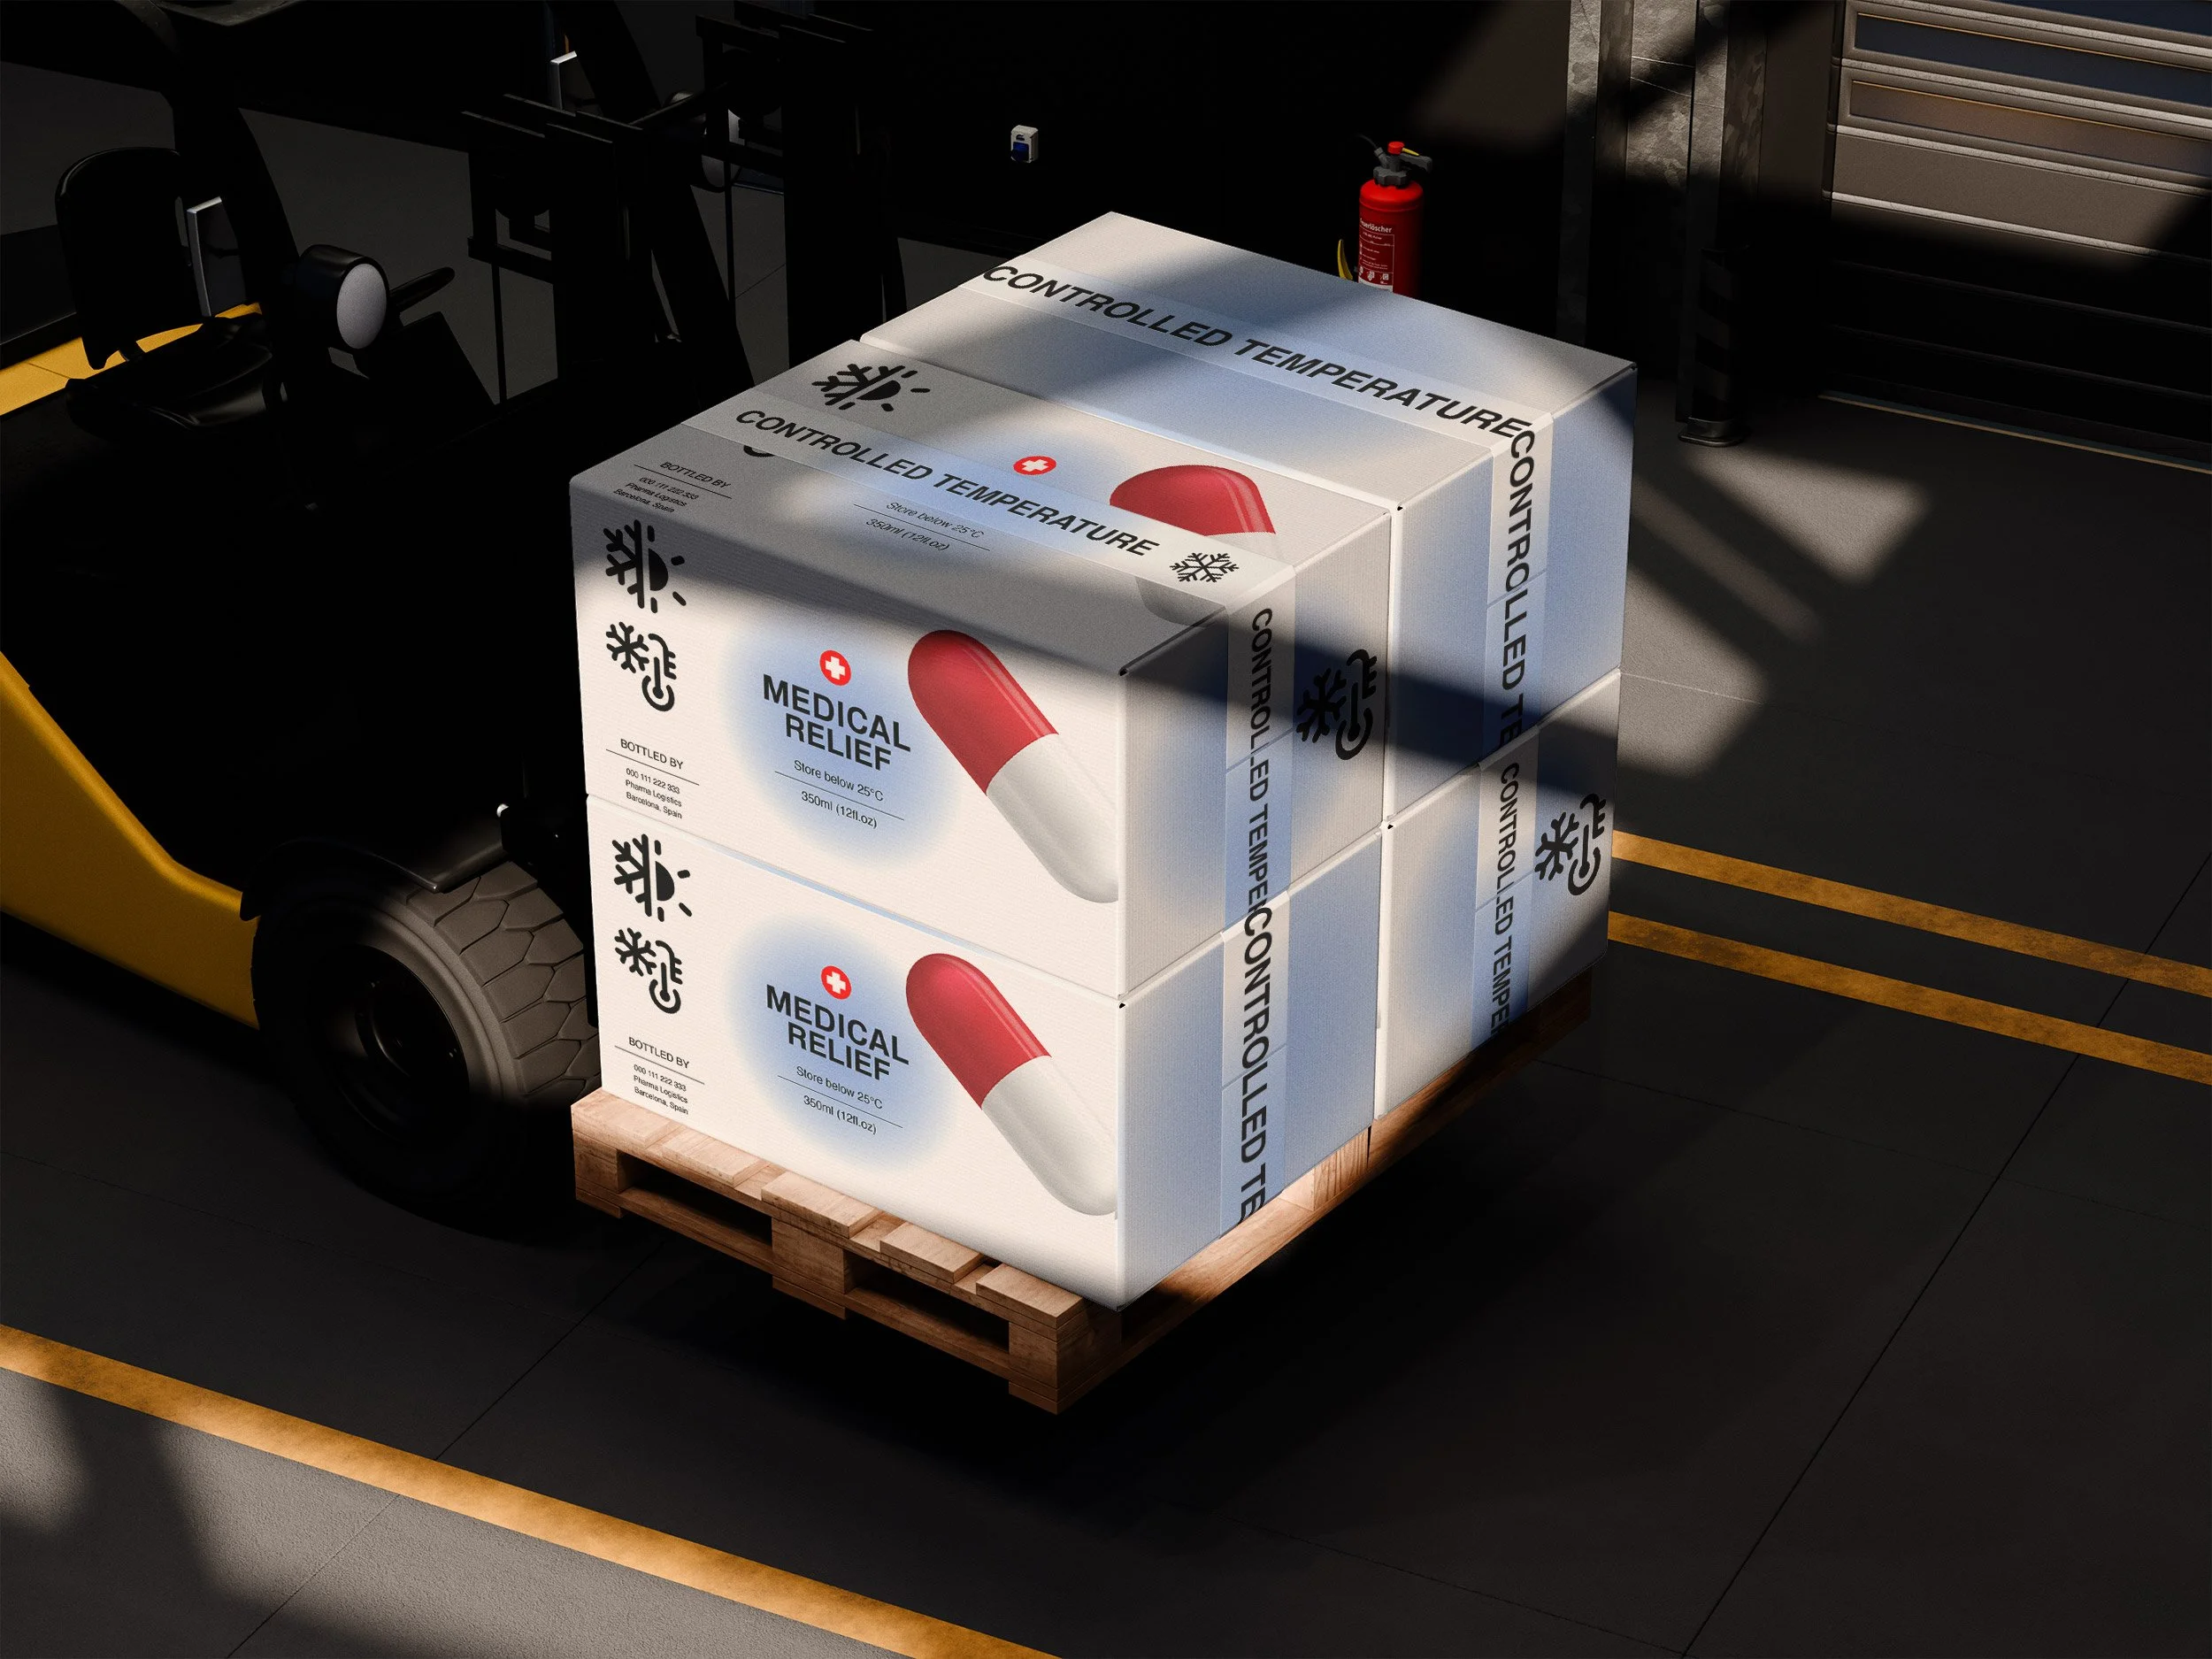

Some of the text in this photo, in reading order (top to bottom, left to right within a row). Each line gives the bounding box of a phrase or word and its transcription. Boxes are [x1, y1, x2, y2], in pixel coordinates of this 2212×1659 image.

[983, 266, 1535, 439] CONTROLLED TEMPERATURE
[660, 462, 732, 488] BOTTLED BY
[736, 410, 1160, 557] CONTROLLED TEMPERATURE
[626, 482, 687, 507] Pharma Logistics
[652, 501, 674, 513] Spain
[865, 518, 905, 534] 350ml
[887, 502, 984, 539] Store below 25°C
[1502, 430, 1535, 691] CONTROLLED
[764, 674, 910, 752] MEDICAL
[1249, 608, 1272, 801] CONTROLLED
[620, 739, 683, 769] BOTTLED BY
[786, 712, 891, 771] RELIEF
[626, 768, 680, 795] 000 111 222 333
[626, 780, 682, 807] Pharma Logistics
[794, 760, 883, 802] Store below 25°C
[663, 806, 682, 818] Spain
[801, 791, 877, 829] 350ml (12fl.oz)
[1494, 762, 1519, 935] CONTROLLED
[766, 984, 909, 1065] MEDICAL
[1240, 907, 1273, 1164] CONTROLLED
[629, 1037, 689, 1069] BOTTLED BY
[788, 1022, 890, 1080] RELIEF
[634, 1064, 687, 1091] 000 111 222 333
[634, 1075, 687, 1103] Pharma Logistics
[796, 1066, 883, 1110] Store below 25°C
[634, 1087, 688, 1115] Barcelona, Spain
[803, 1095, 877, 1134] 350ml (12fl.oz)
